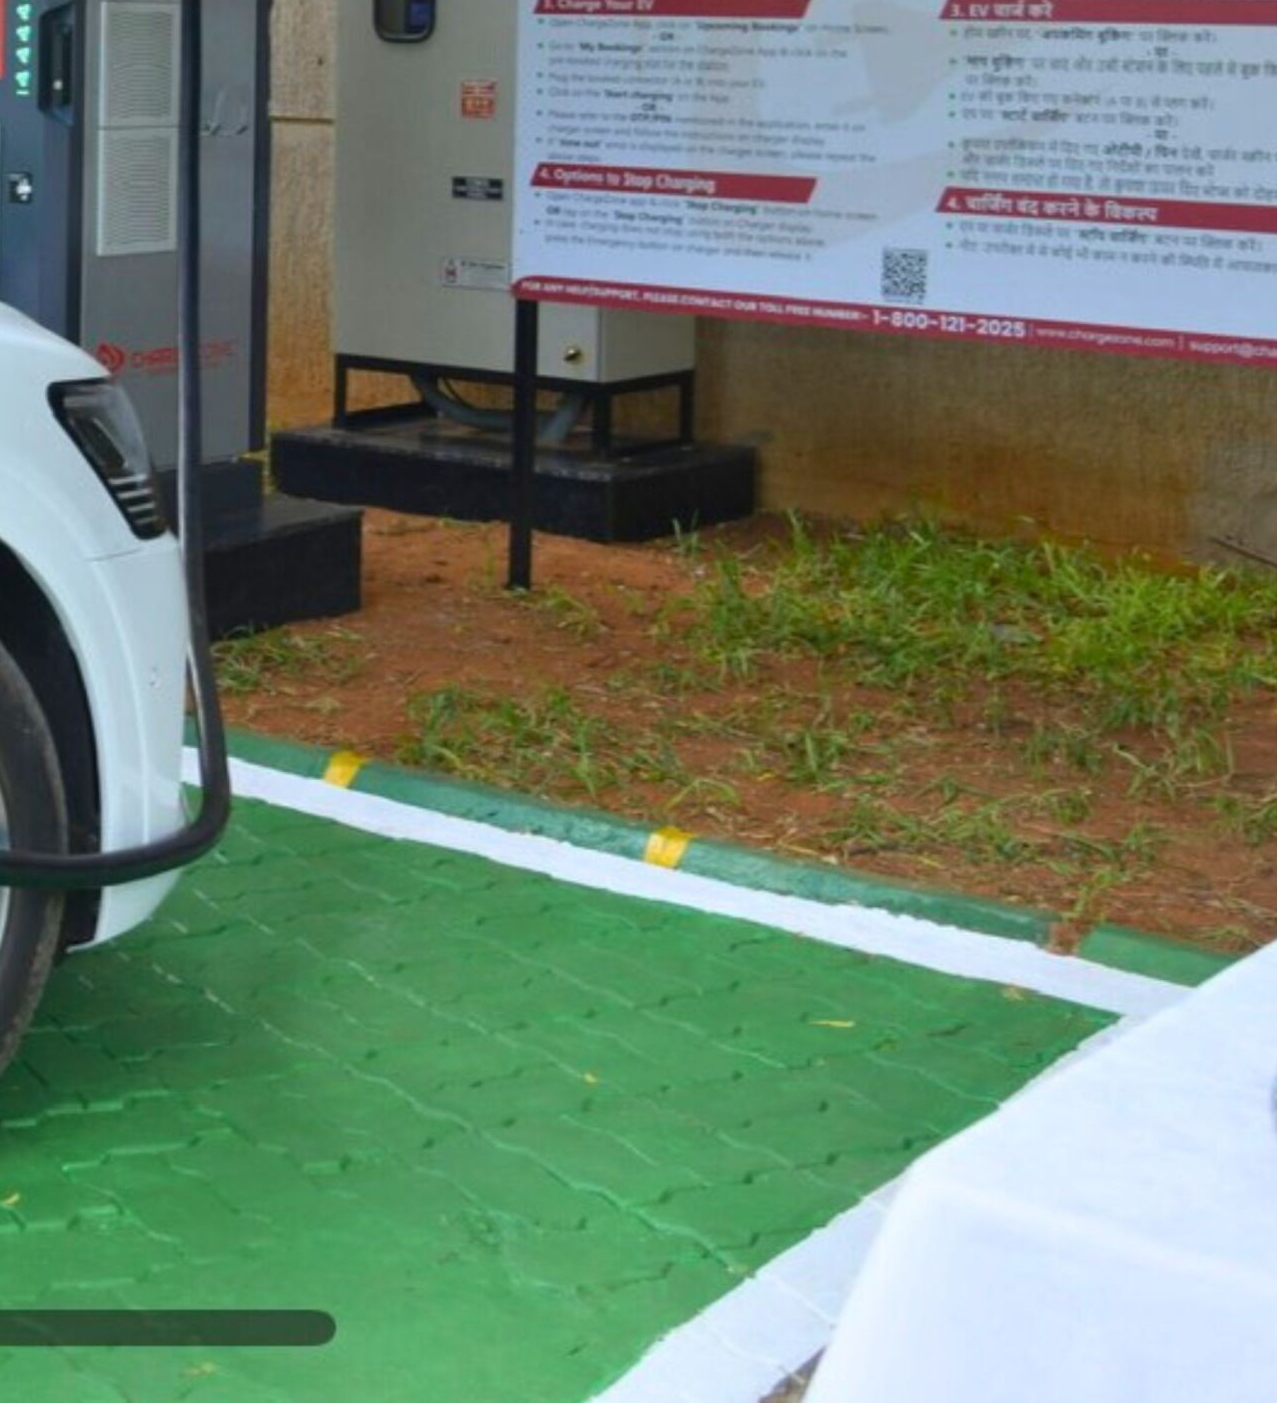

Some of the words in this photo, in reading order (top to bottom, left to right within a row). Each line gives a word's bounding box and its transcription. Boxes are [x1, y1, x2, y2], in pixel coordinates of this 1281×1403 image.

[637, 0, 654, 10] EV
[951, 4, 966, 17] 3.
[970, 4, 989, 17] EV
[540, 169, 551, 179] 4.
[554, 169, 603, 187] Options
[607, 171, 620, 185] to
[624, 172, 652, 190] Stop
[656, 174, 716, 194] Charging
[946, 198, 960, 211] 4.
[872, 308, 1025, 339] 1-800-121-2025
